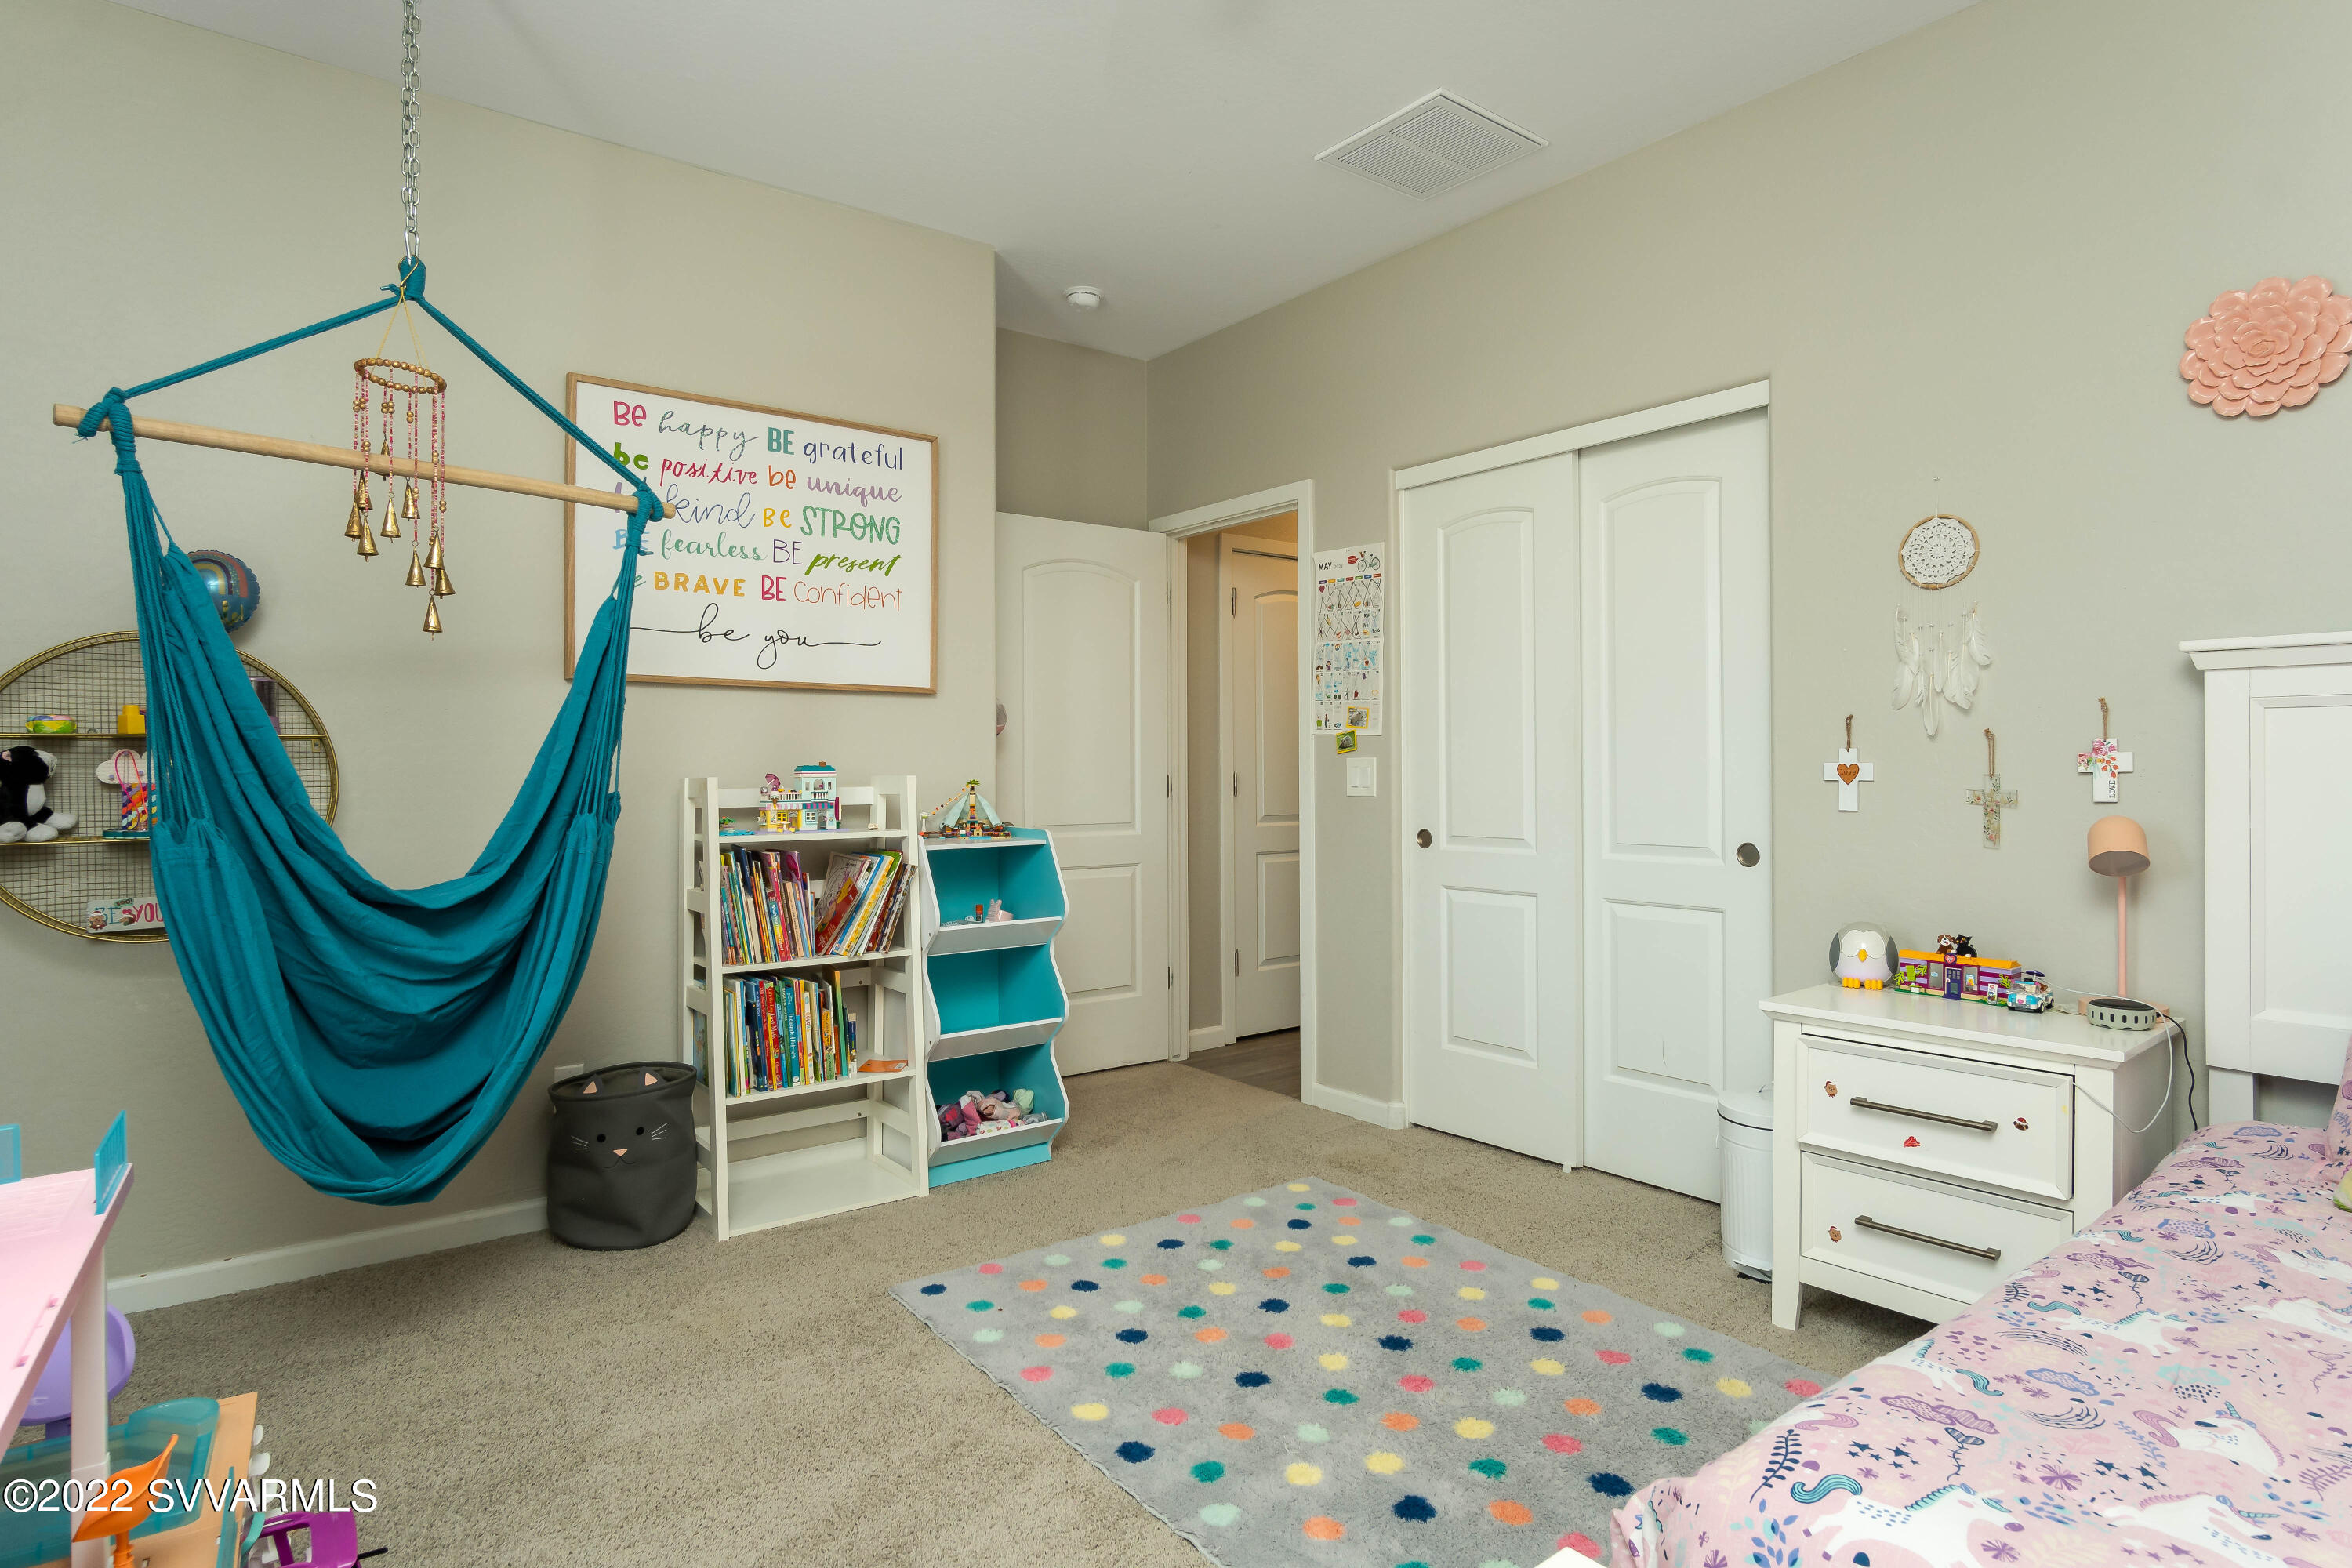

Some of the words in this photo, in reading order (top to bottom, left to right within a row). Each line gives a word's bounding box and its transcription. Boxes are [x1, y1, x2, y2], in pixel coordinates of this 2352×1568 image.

[613, 401, 647, 427] Be
[659, 410, 758, 461] happy
[768, 427, 794, 456] BE
[803, 440, 904, 470] grateful
[660, 457, 757, 486] positive
[768, 465, 797, 490] be
[807, 475, 902, 507] unique
[666, 483, 756, 528] kind
[763, 507, 792, 528] Be
[800, 506, 901, 545] STRONG
[662, 532, 768, 561] fearless
[773, 539, 803, 565] BE
[805, 550, 902, 576] present
[1319, 561, 1332, 571] MAY
[654, 571, 745, 597] BRAVE
[761, 575, 787, 601] BE
[681, 603, 750, 643] be
[757, 629, 831, 670] you
